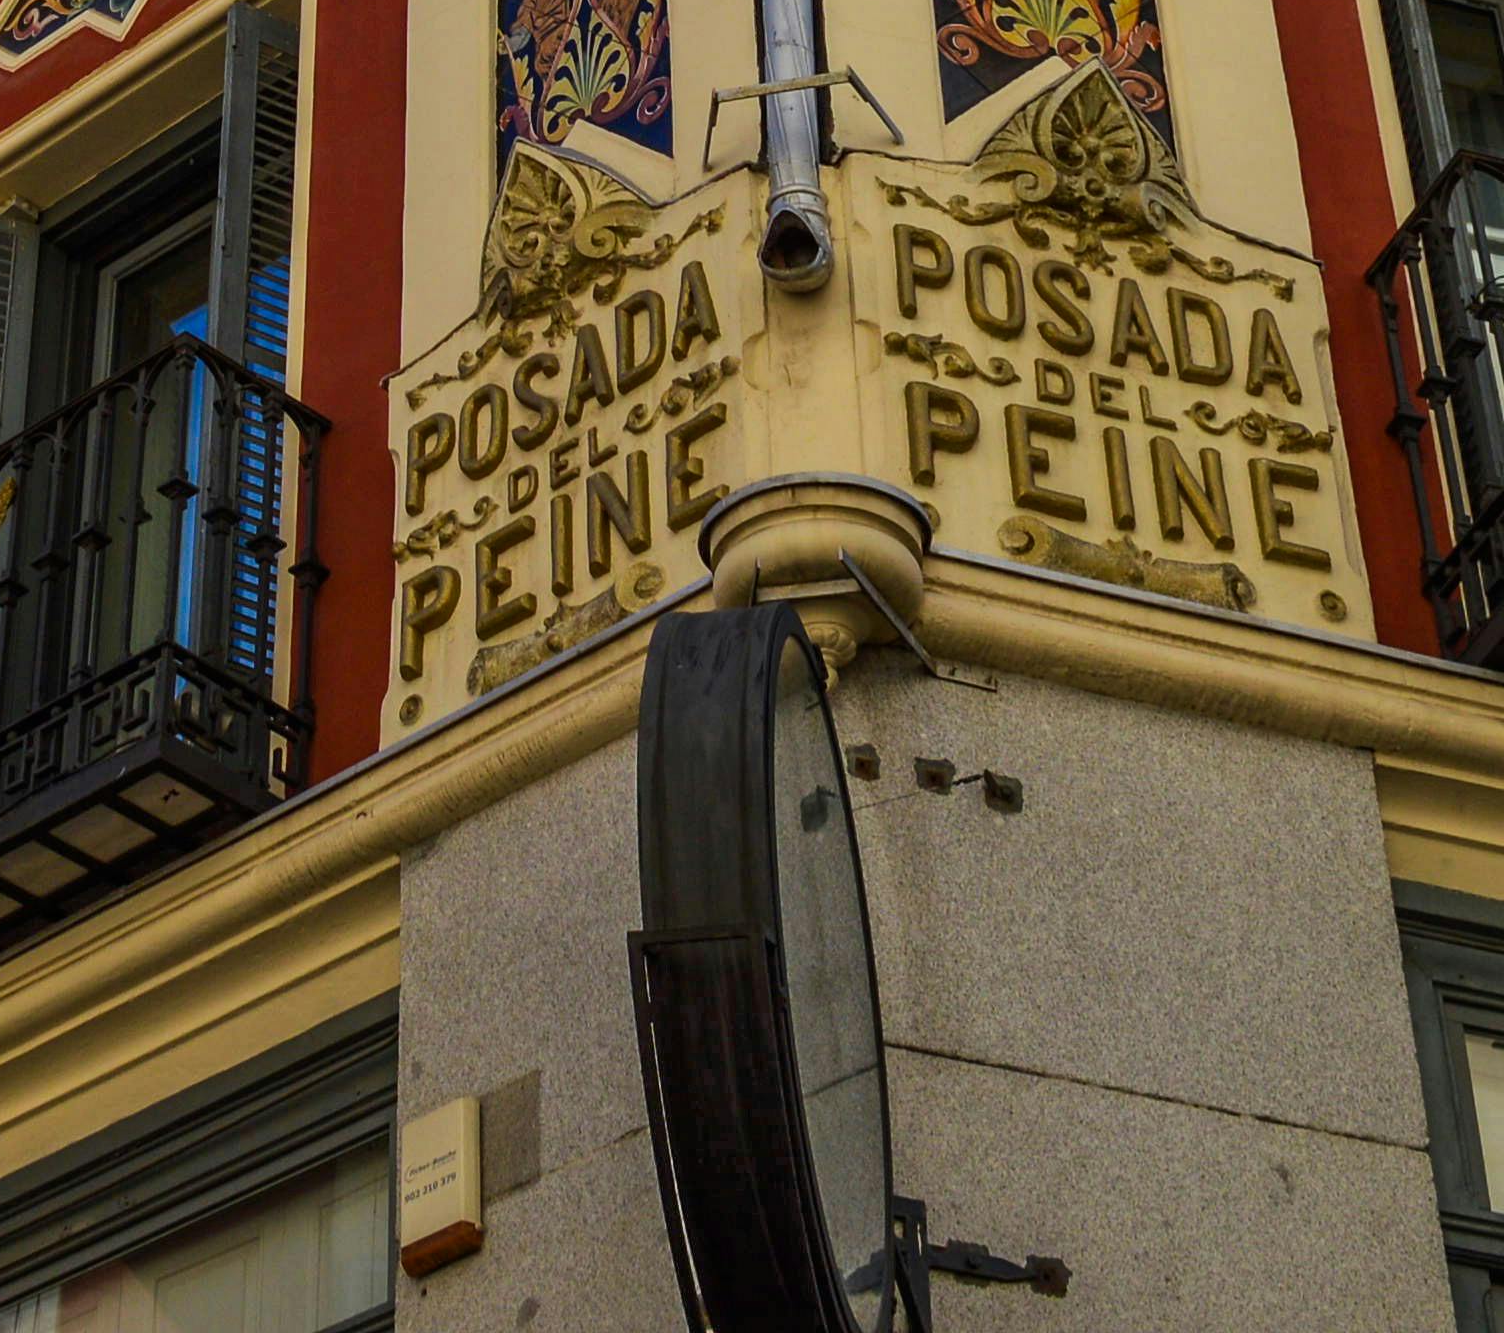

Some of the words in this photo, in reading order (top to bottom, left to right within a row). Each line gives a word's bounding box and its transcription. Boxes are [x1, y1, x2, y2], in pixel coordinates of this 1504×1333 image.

[405, 261, 720, 516] POSADA
[892, 223, 1302, 405] POSADA
[1034, 358, 1177, 431] DEL
[399, 402, 729, 681] PEINE
[508, 426, 618, 514] DEL
[904, 381, 1331, 572] PEINE
